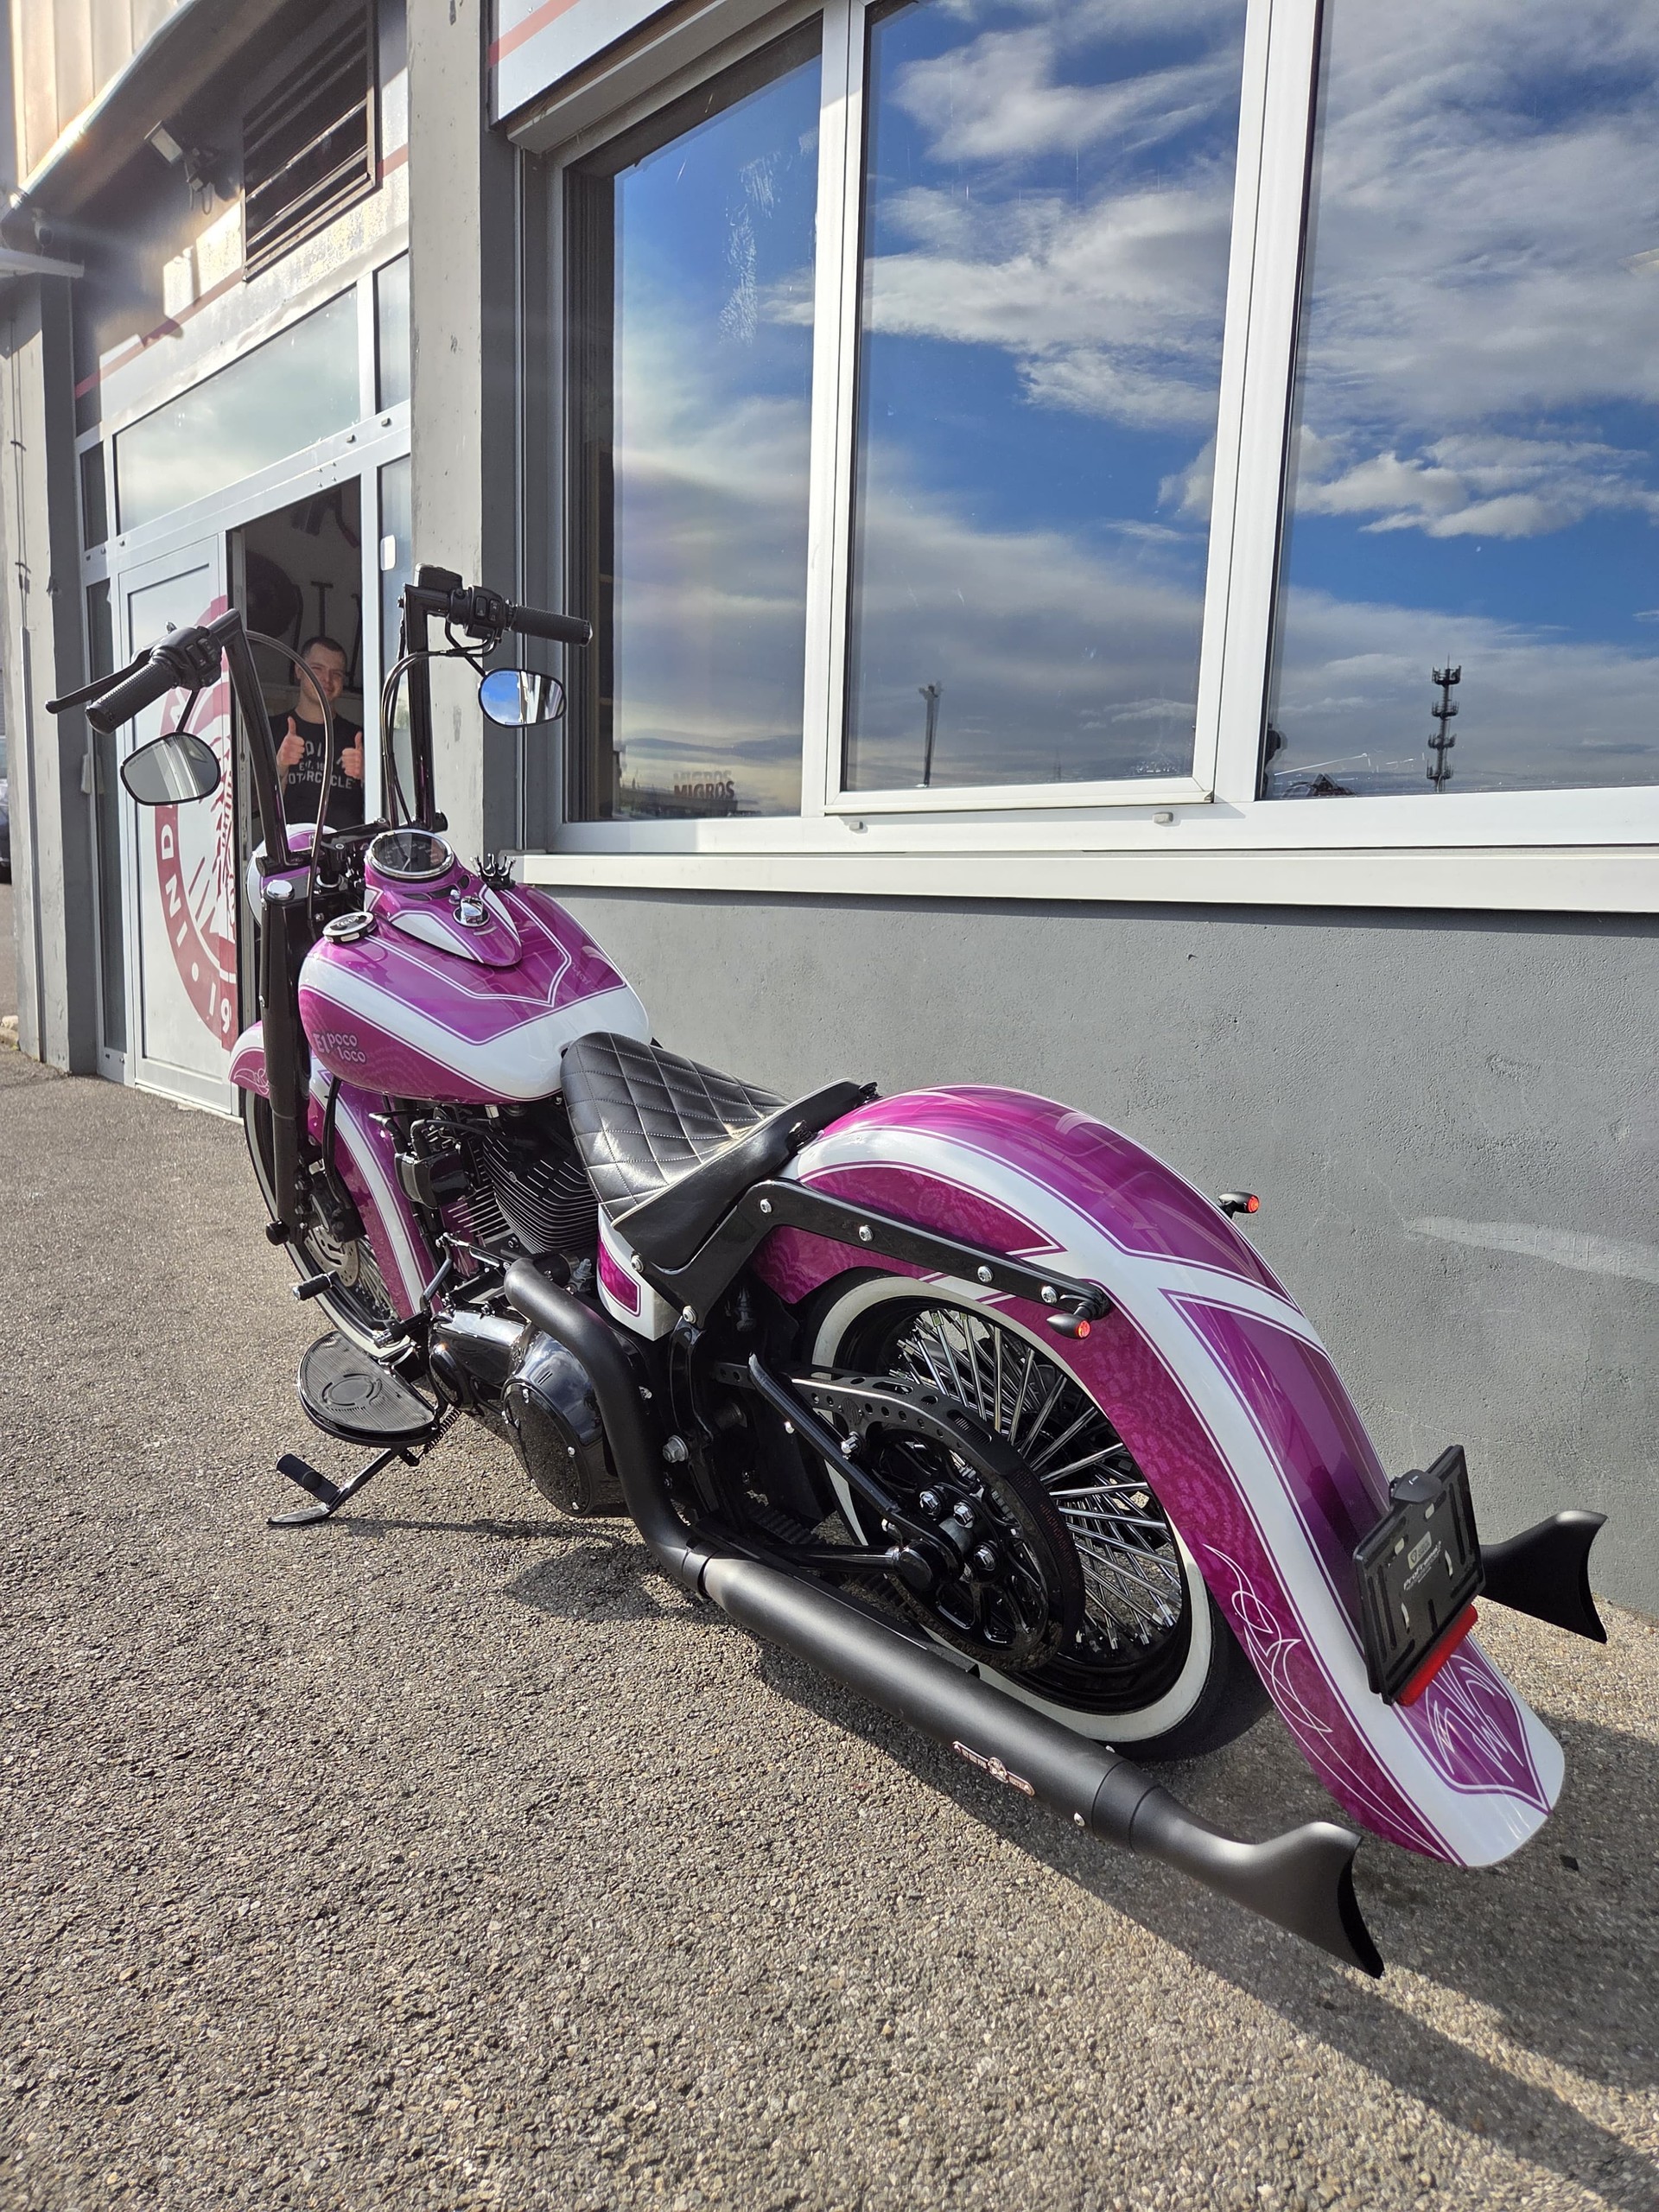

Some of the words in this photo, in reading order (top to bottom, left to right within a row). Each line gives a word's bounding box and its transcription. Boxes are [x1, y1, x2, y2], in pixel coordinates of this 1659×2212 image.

[674, 780, 735, 800] MIGROS
[327, 1033, 358, 1048] poco
[336, 1046, 366, 1063] loco
